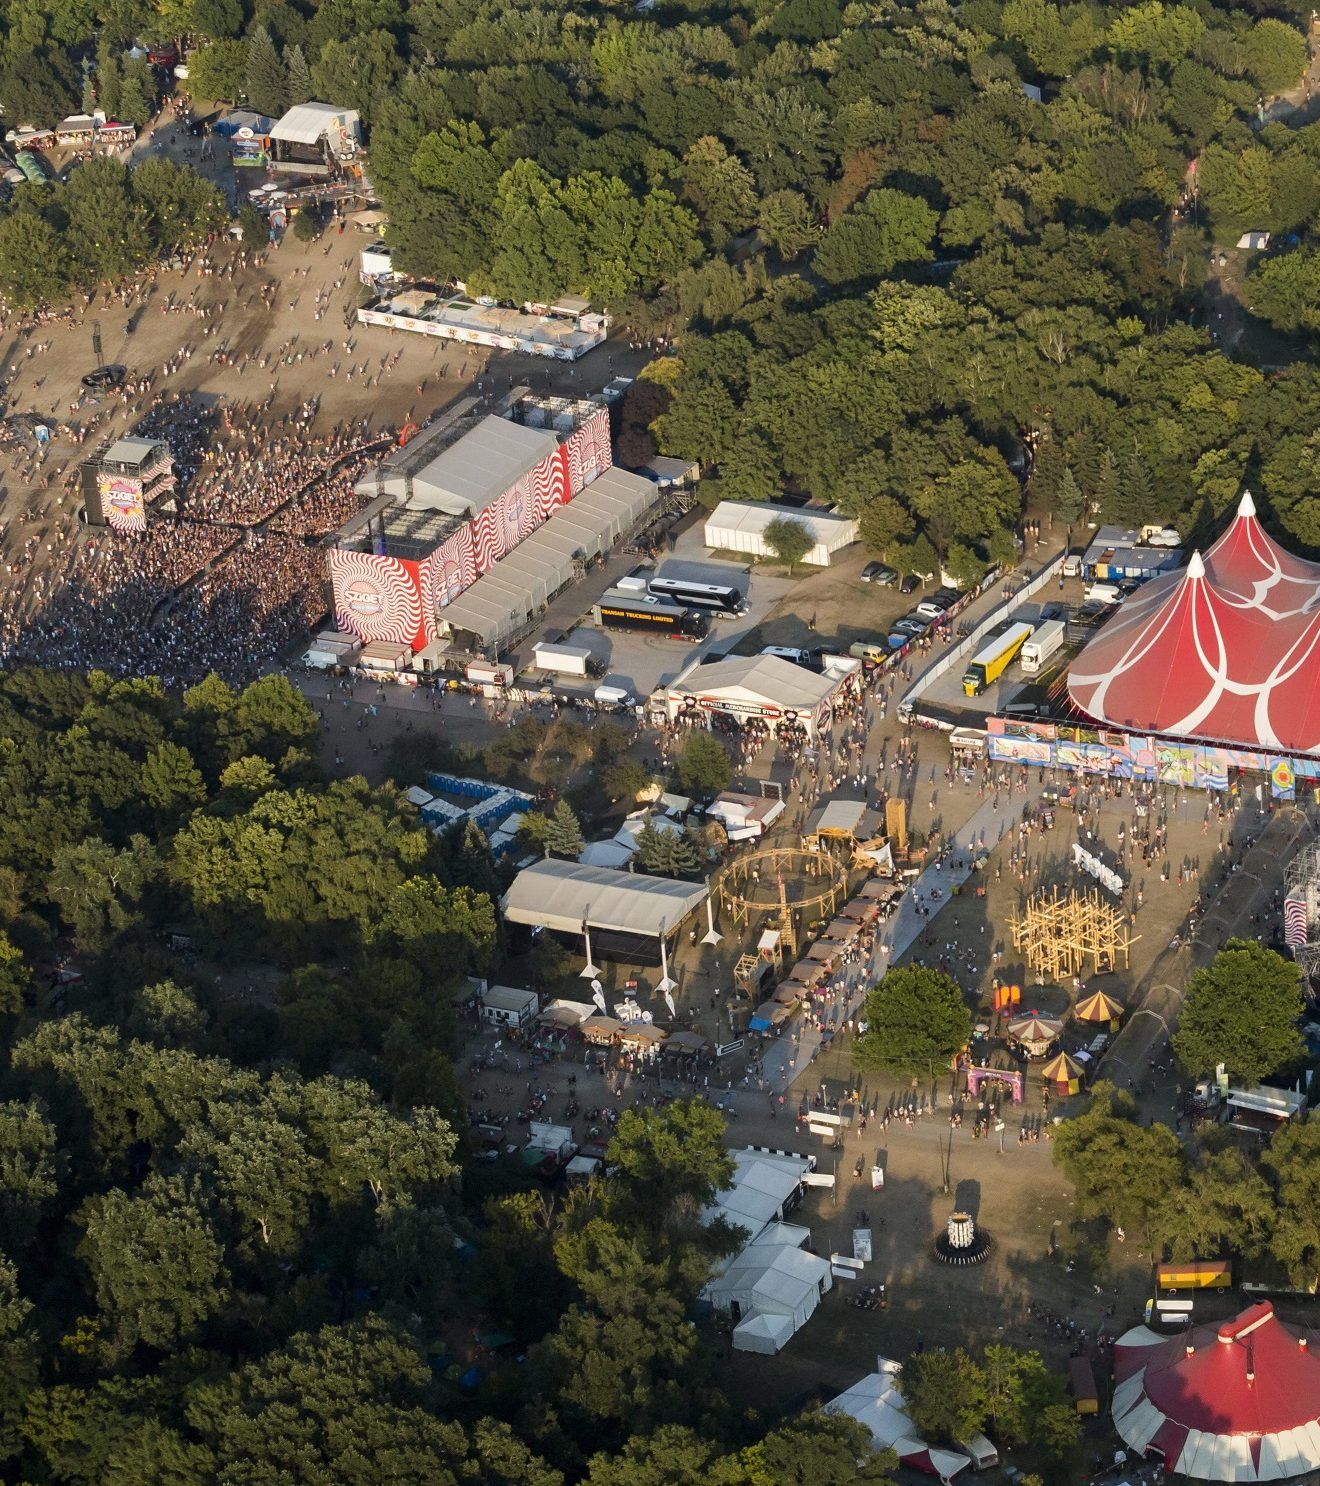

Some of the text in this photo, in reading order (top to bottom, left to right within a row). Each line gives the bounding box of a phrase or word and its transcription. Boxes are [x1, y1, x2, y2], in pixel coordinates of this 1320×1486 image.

[344, 590, 384, 605] SZIGET
[626, 612, 652, 620] TRUCKING
[653, 615, 674, 623] LIMITED
[725, 704, 762, 713] MERCHANDISE
[762, 708, 780, 716] STORE
